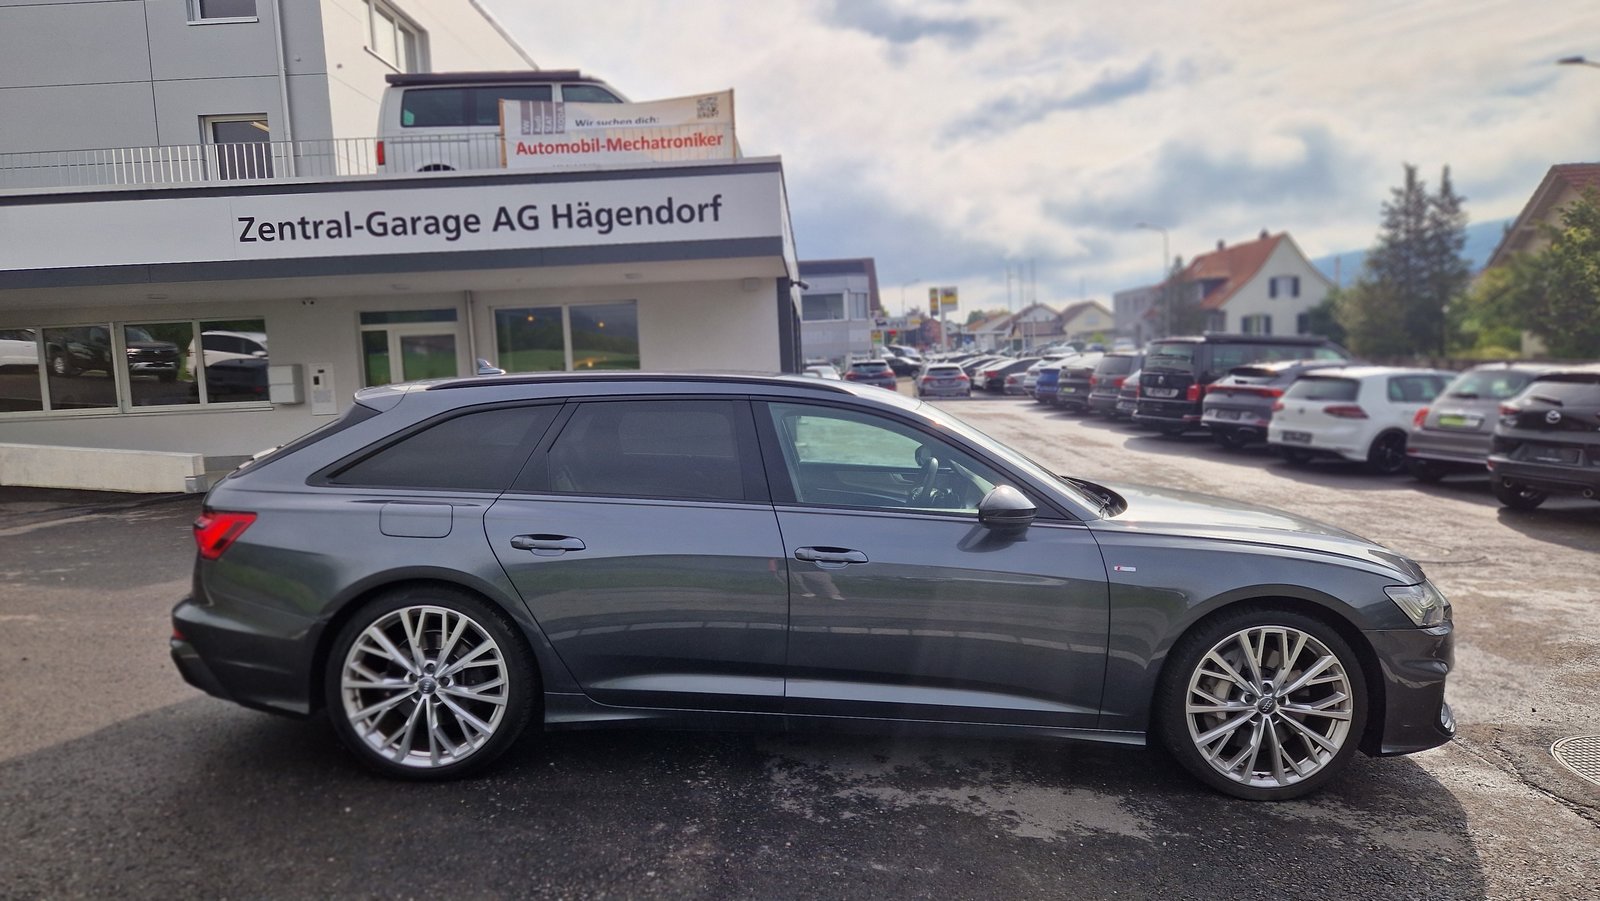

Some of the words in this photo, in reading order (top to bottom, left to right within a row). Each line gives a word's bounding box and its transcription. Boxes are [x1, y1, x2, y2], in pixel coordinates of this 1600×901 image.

[575, 119, 593, 127] Wir
[596, 118, 632, 126] suchen
[634, 116, 659, 125] dich:
[516, 133, 723, 155] Automobil-Mechatroniker
[237, 210, 481, 243] Zentral-Garage
[492, 205, 540, 232] AG
[551, 195, 723, 235] Hägendorf
